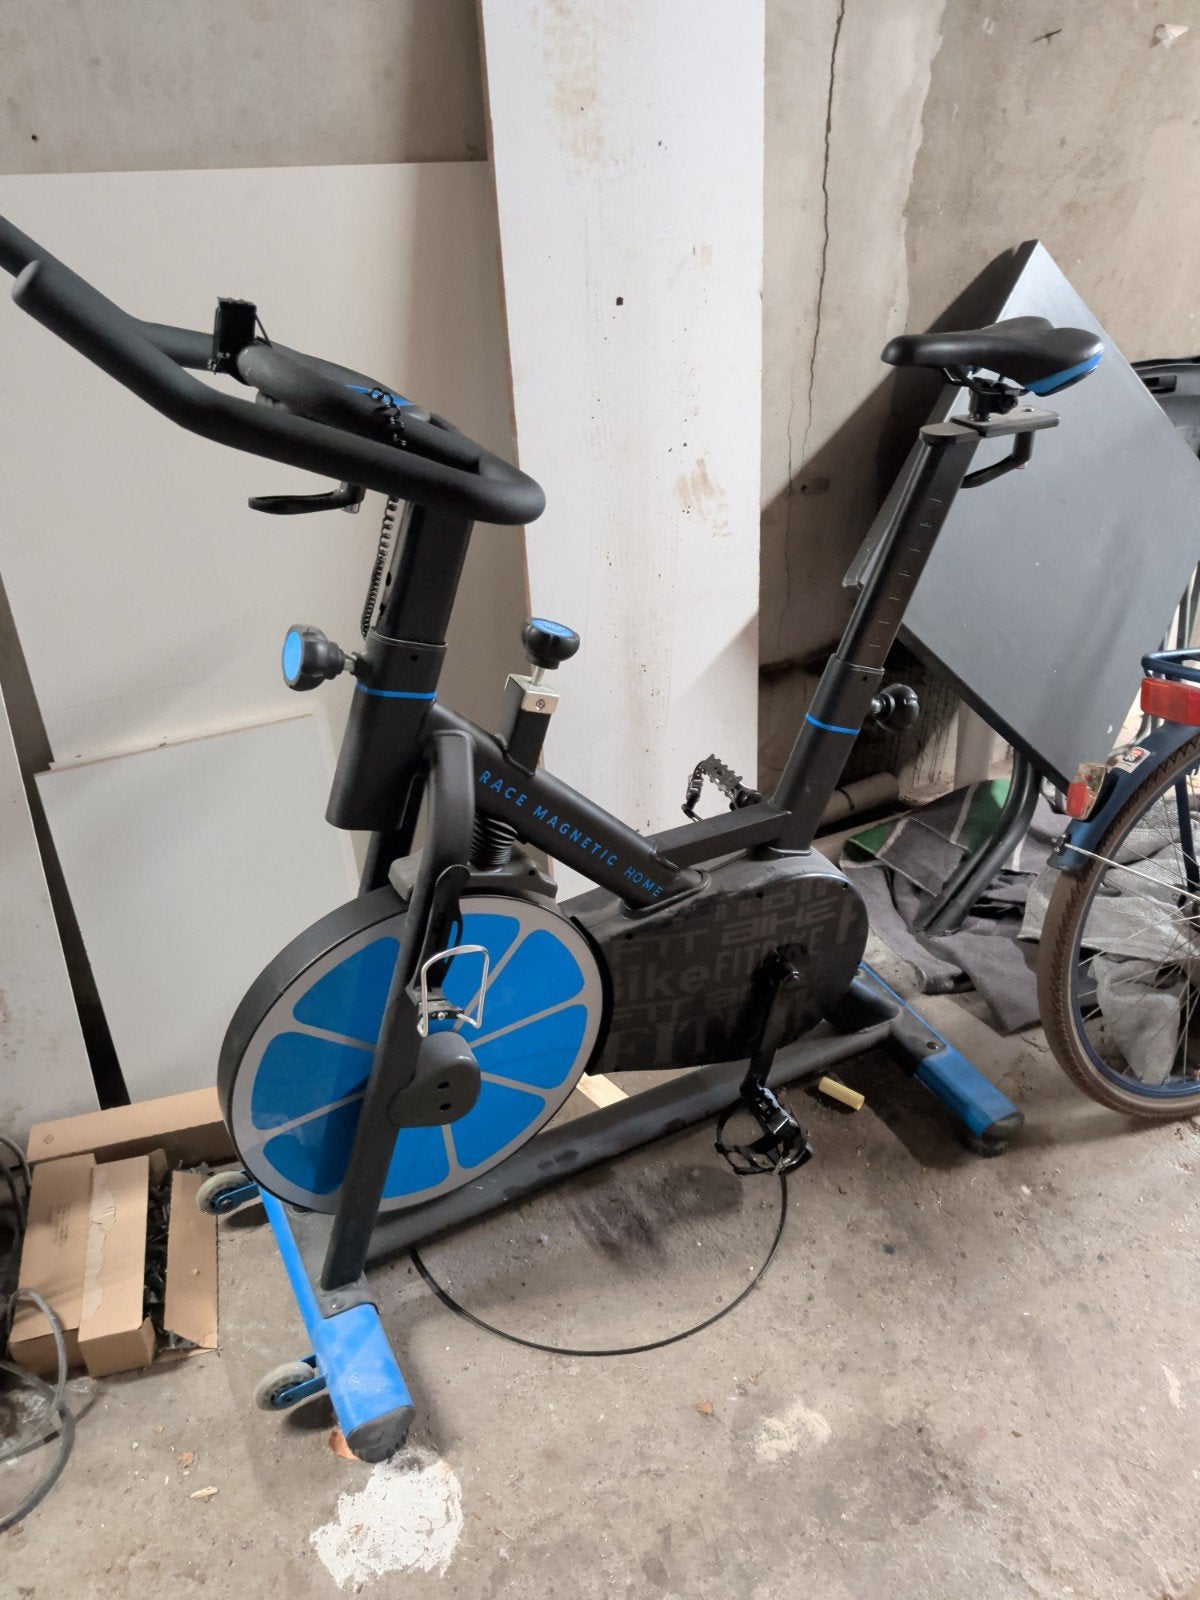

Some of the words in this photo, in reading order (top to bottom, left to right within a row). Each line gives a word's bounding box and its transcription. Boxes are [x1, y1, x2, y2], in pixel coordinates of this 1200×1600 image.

[478, 769, 528, 807] RACE
[532, 805, 619, 866] MAGNETIC
[623, 866, 664, 898] HOME
